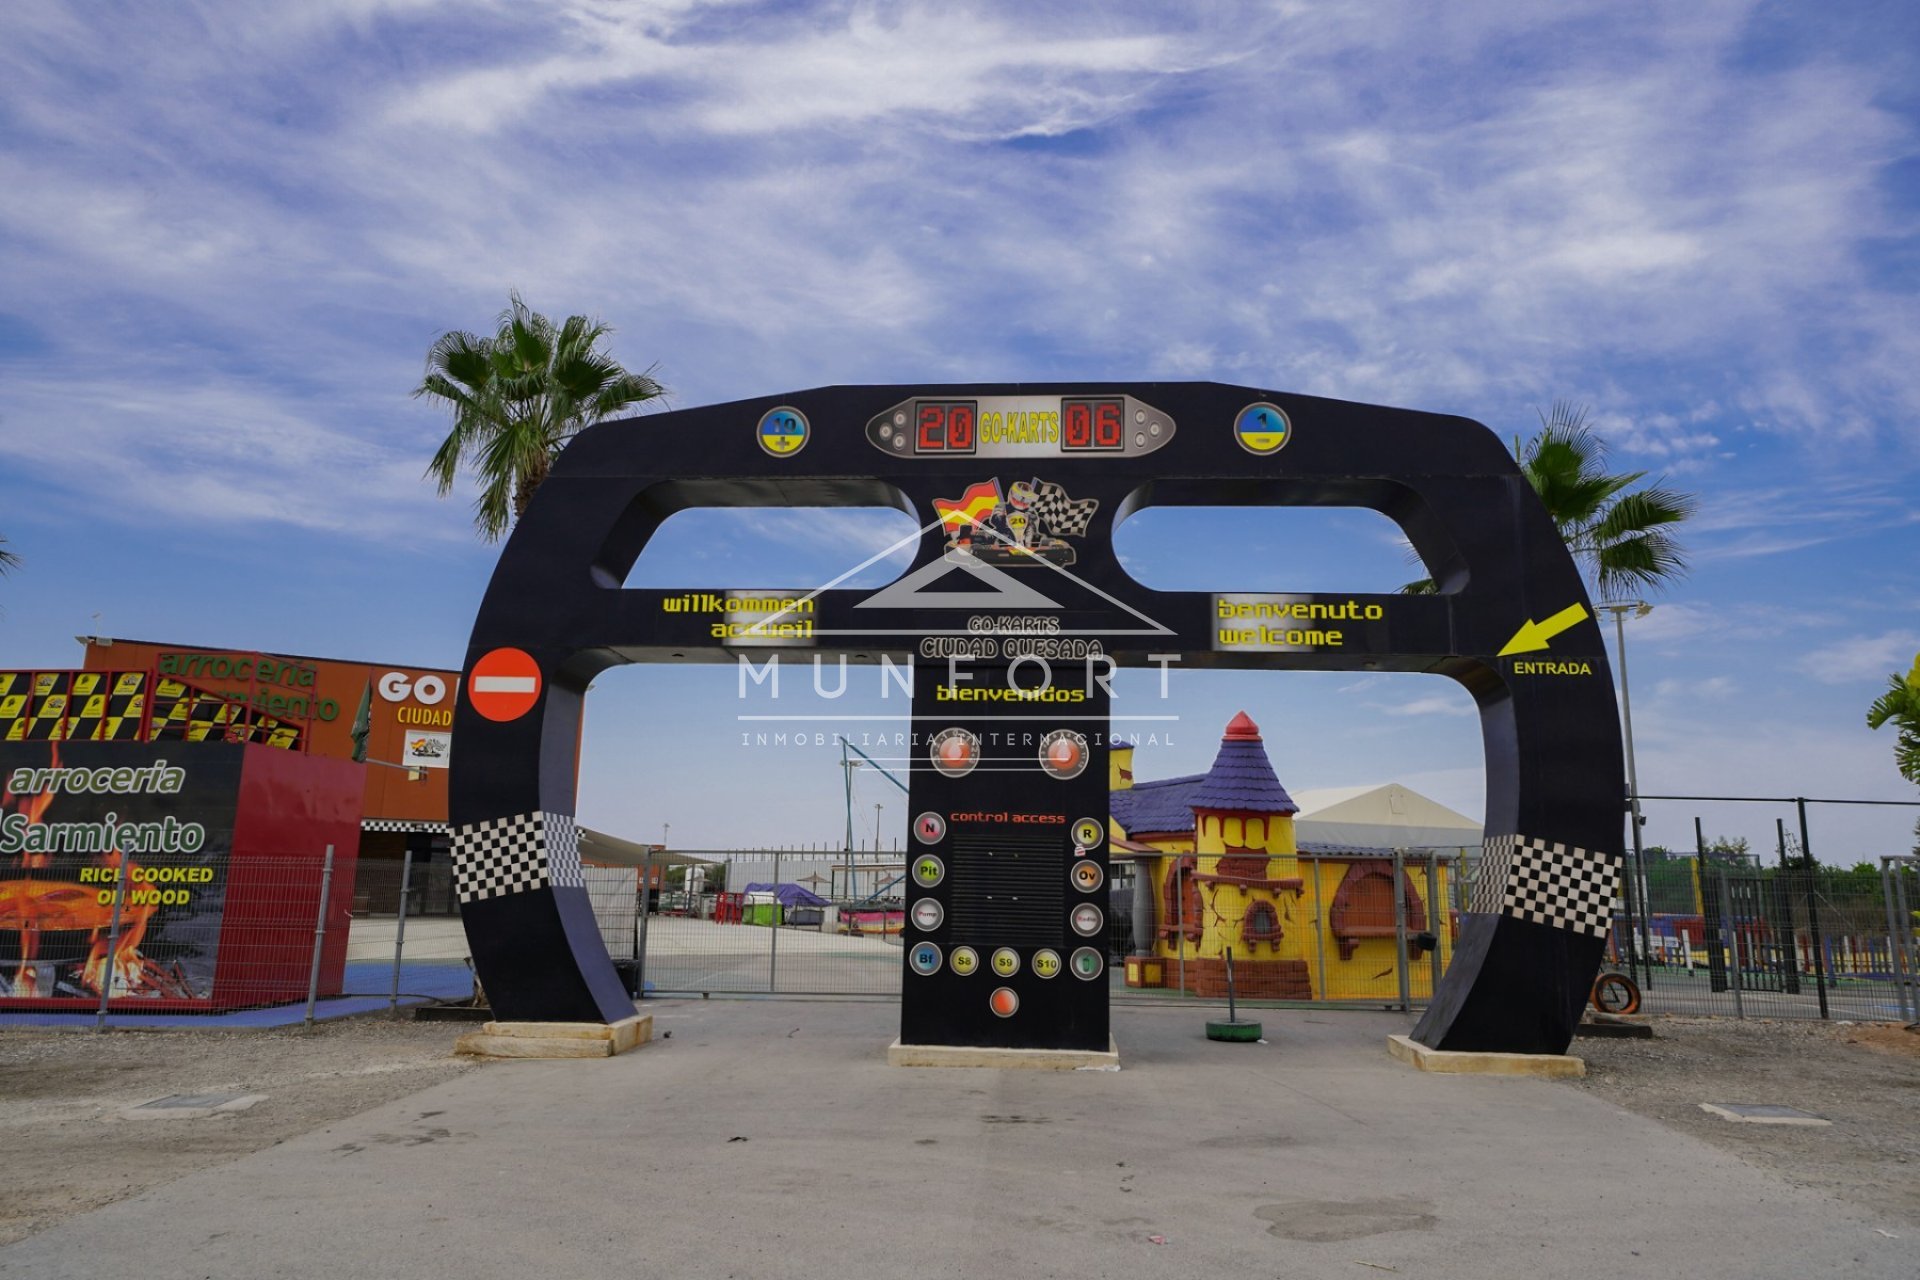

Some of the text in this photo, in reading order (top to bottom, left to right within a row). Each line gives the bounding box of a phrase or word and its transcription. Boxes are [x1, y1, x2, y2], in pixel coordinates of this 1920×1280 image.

[773, 417, 797, 433] 10
[919, 403, 1122, 448] 20 GO-KARTS 06
[1010, 514, 1027, 525] 20
[663, 594, 814, 614] willkommen
[1218, 599, 1383, 620] benvenuto
[711, 620, 813, 639] accueil
[968, 615, 1061, 635] GO-KARTS
[1219, 626, 1344, 646] welcome
[920, 637, 1105, 661] CIUDAD QUESADA
[1513, 661, 1592, 676] ENTRADA
[378, 671, 446, 705] GO
[936, 685, 1086, 702] bienvenidos
[397, 706, 452, 726] CIUDAD
[950, 811, 1066, 825] control access
[1, 812, 205, 853] Sarmiento
[925, 823, 936, 833] N
[1083, 829, 1092, 838] R
[131, 868, 213, 882] COOKED
[920, 866, 938, 877] Pit
[1079, 870, 1096, 881] Ov
[131, 890, 190, 905] WOOD
[919, 954, 933, 964] Bf
[958, 956, 972, 966] S8
[999, 957, 1013, 967] S9
[1037, 959, 1057, 969] S10
